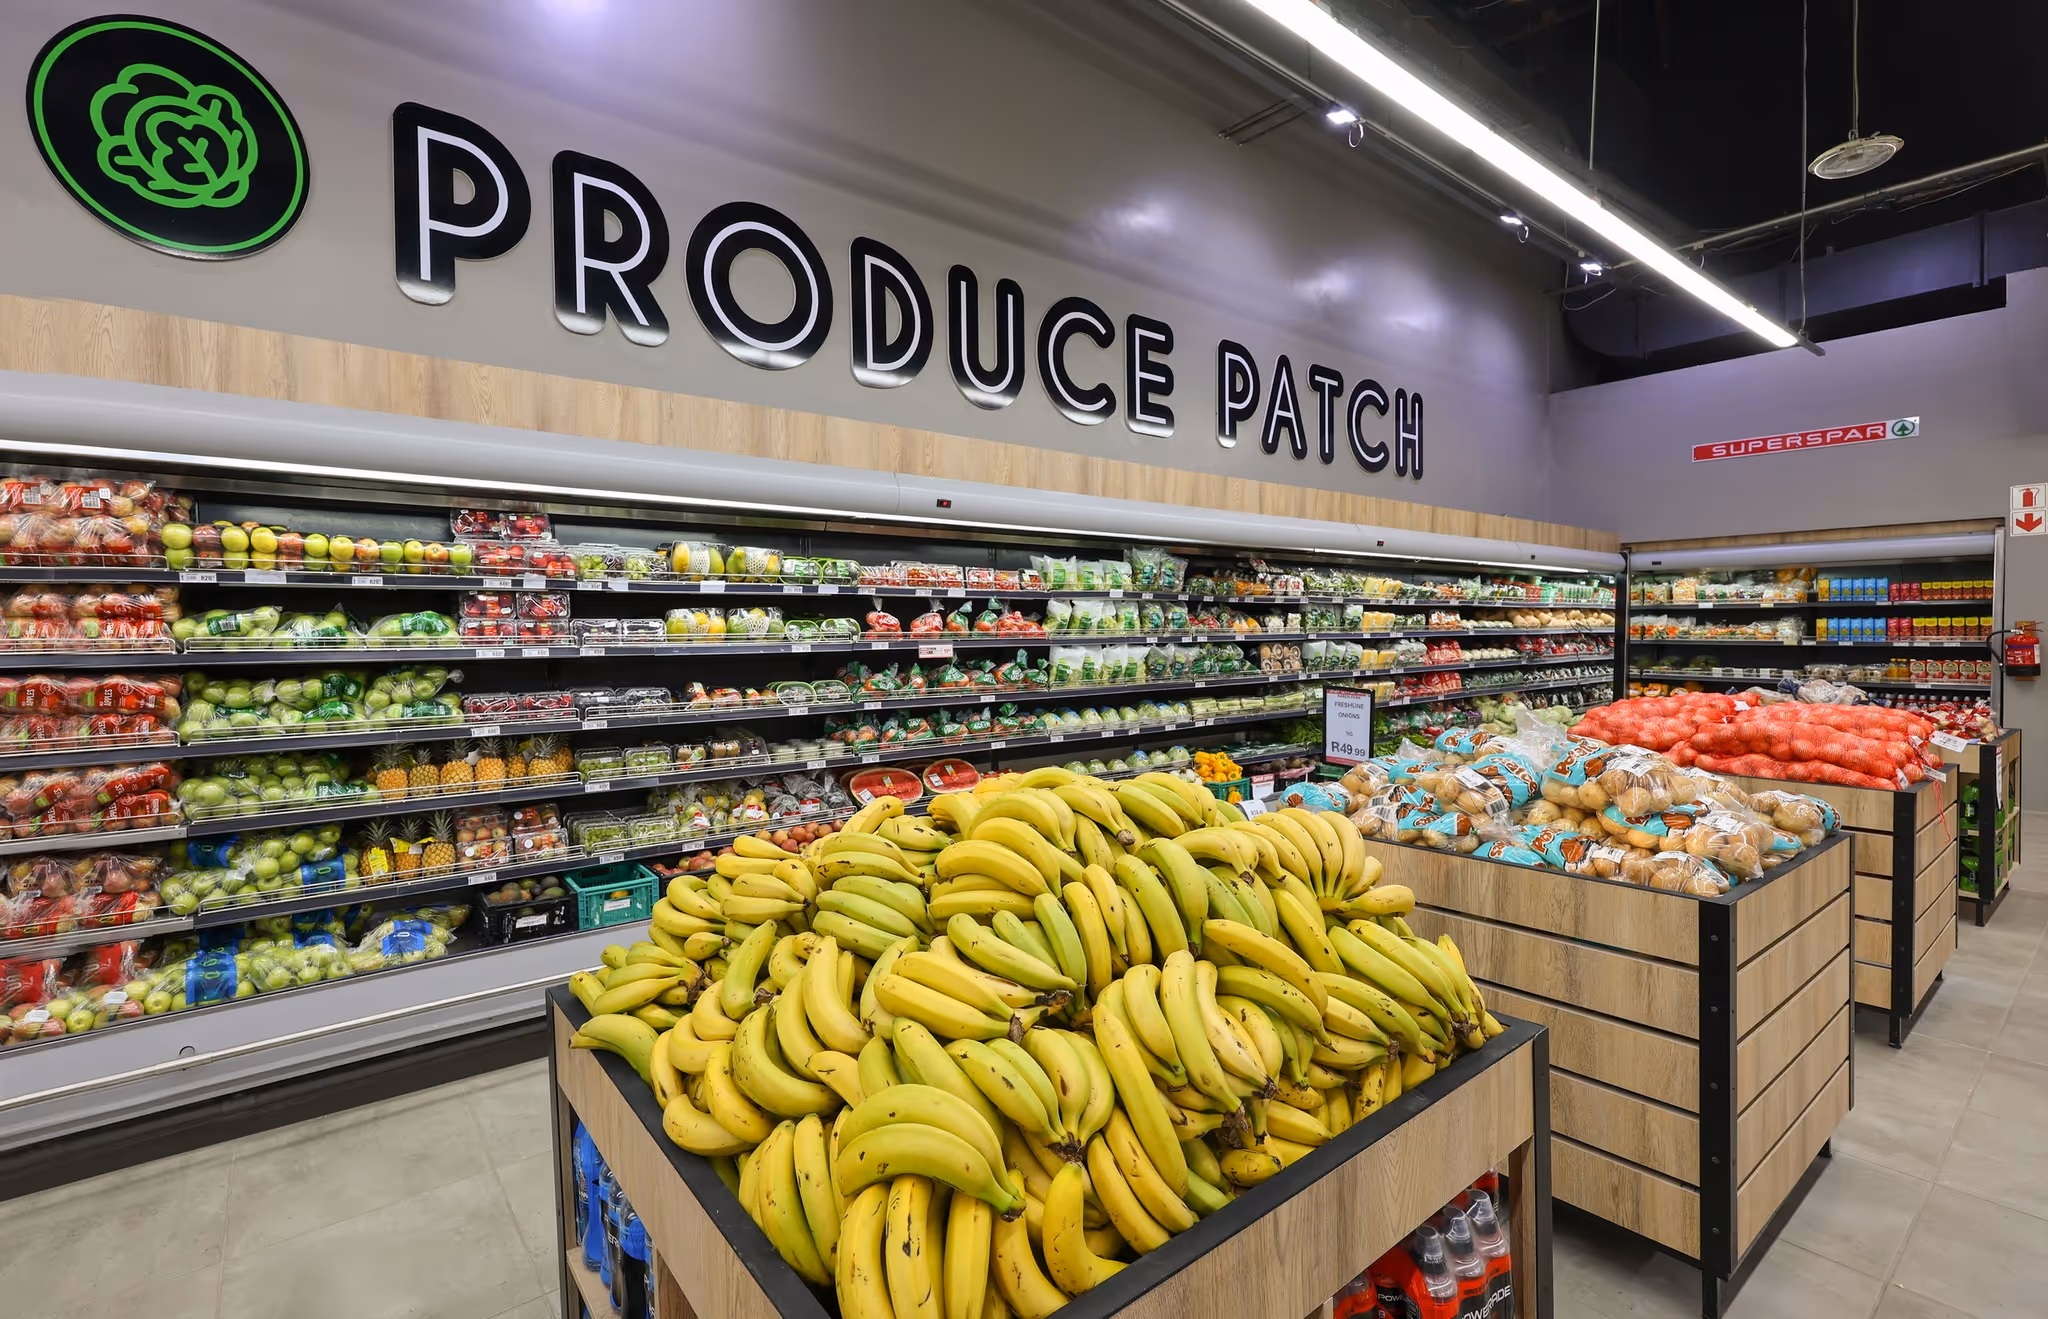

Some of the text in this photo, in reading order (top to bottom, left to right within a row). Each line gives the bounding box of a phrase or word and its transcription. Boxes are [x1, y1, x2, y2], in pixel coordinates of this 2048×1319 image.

[392, 101, 1424, 480] PRODUCE PATCH
[1712, 425, 1884, 457] SUPERSPAR
[26, 689, 35, 706] APPLES
[104, 689, 113, 706] APPLES
[1334, 701, 1364, 709] FRESHLINE
[1331, 741, 1366, 757] R49.99
[1463, 1285, 1511, 1319] OWERADE
